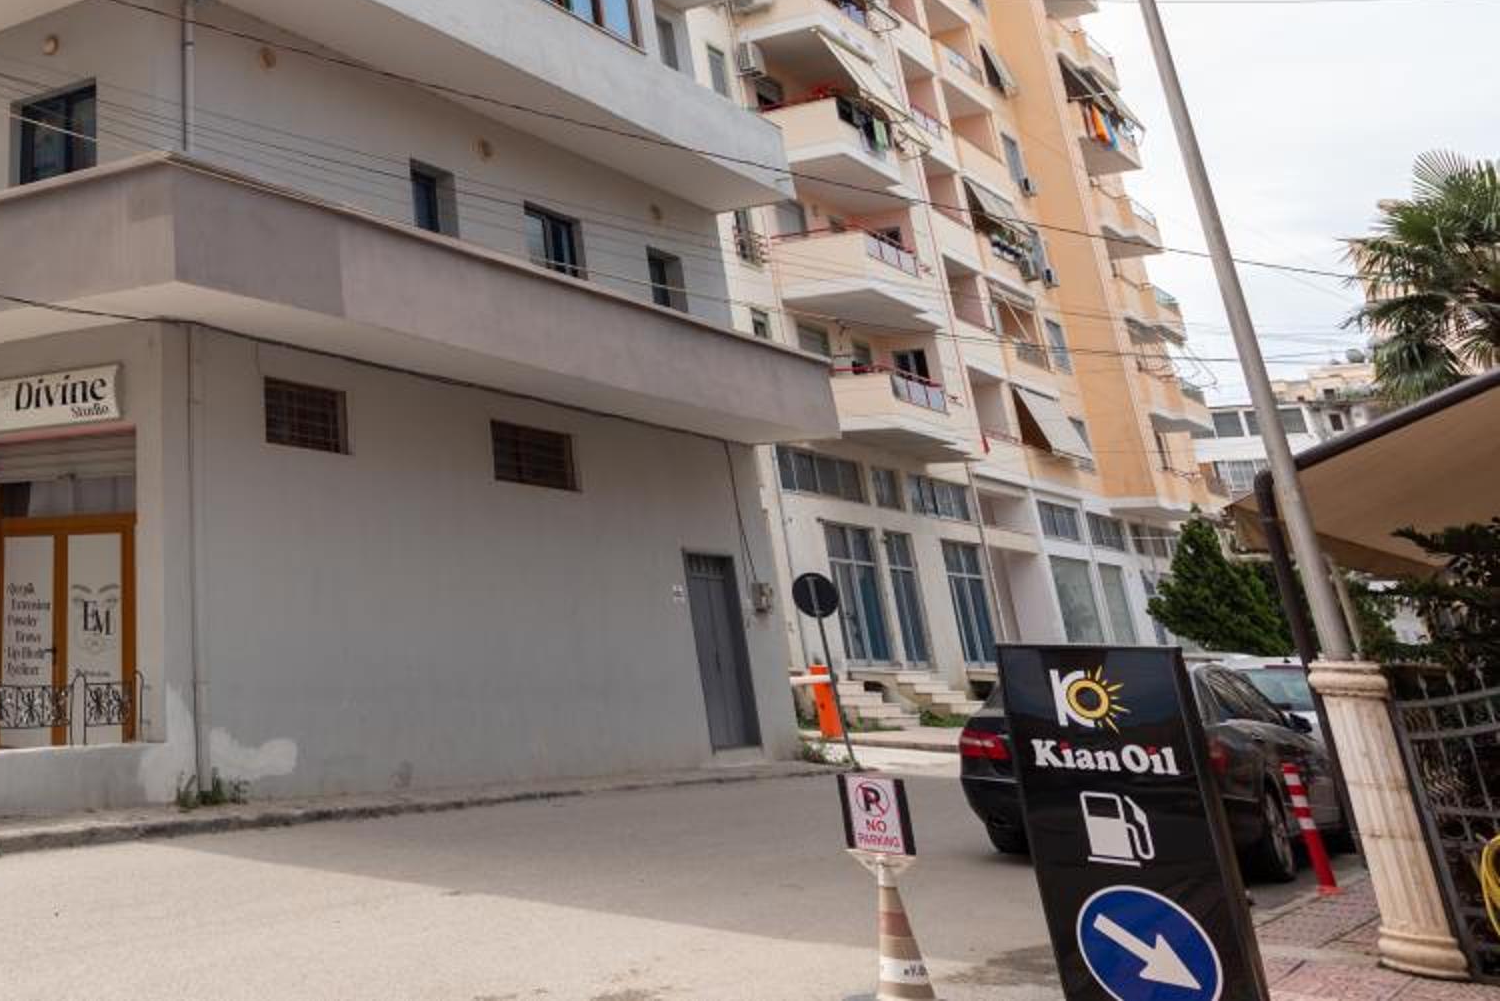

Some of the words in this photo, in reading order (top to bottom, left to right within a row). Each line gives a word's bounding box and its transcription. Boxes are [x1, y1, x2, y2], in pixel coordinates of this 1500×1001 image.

[15, 374, 107, 411] Divine
[70, 402, 108, 418] Studio
[865, 819, 887, 834] NO
[857, 833, 901, 848] PARKING
